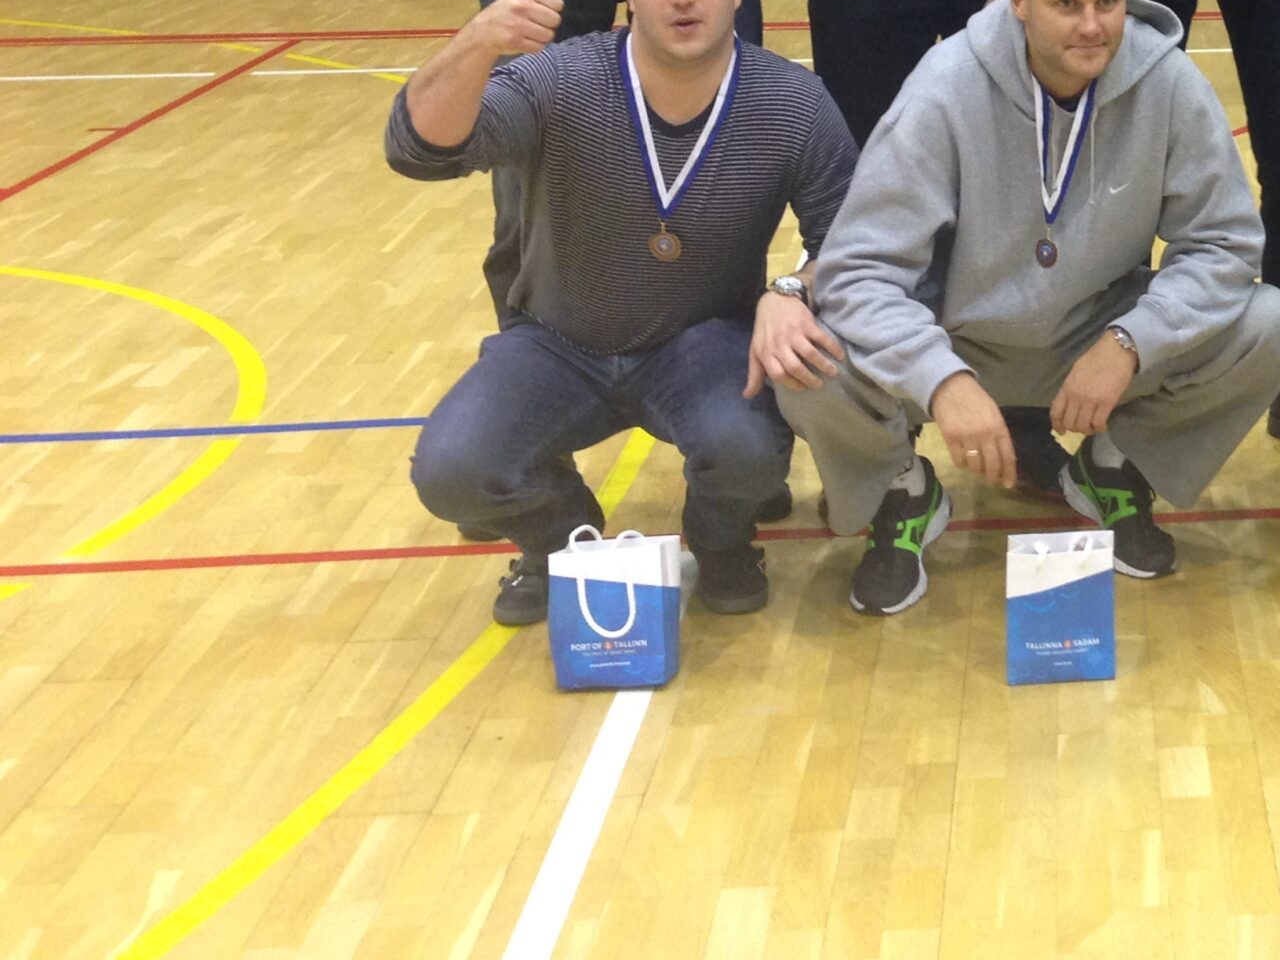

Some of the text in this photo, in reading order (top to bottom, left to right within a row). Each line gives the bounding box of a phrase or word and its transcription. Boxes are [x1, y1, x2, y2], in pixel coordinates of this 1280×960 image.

[570, 639, 648, 651] PORT OF TALLINN
[1025, 641, 1063, 649] TALLINNA
